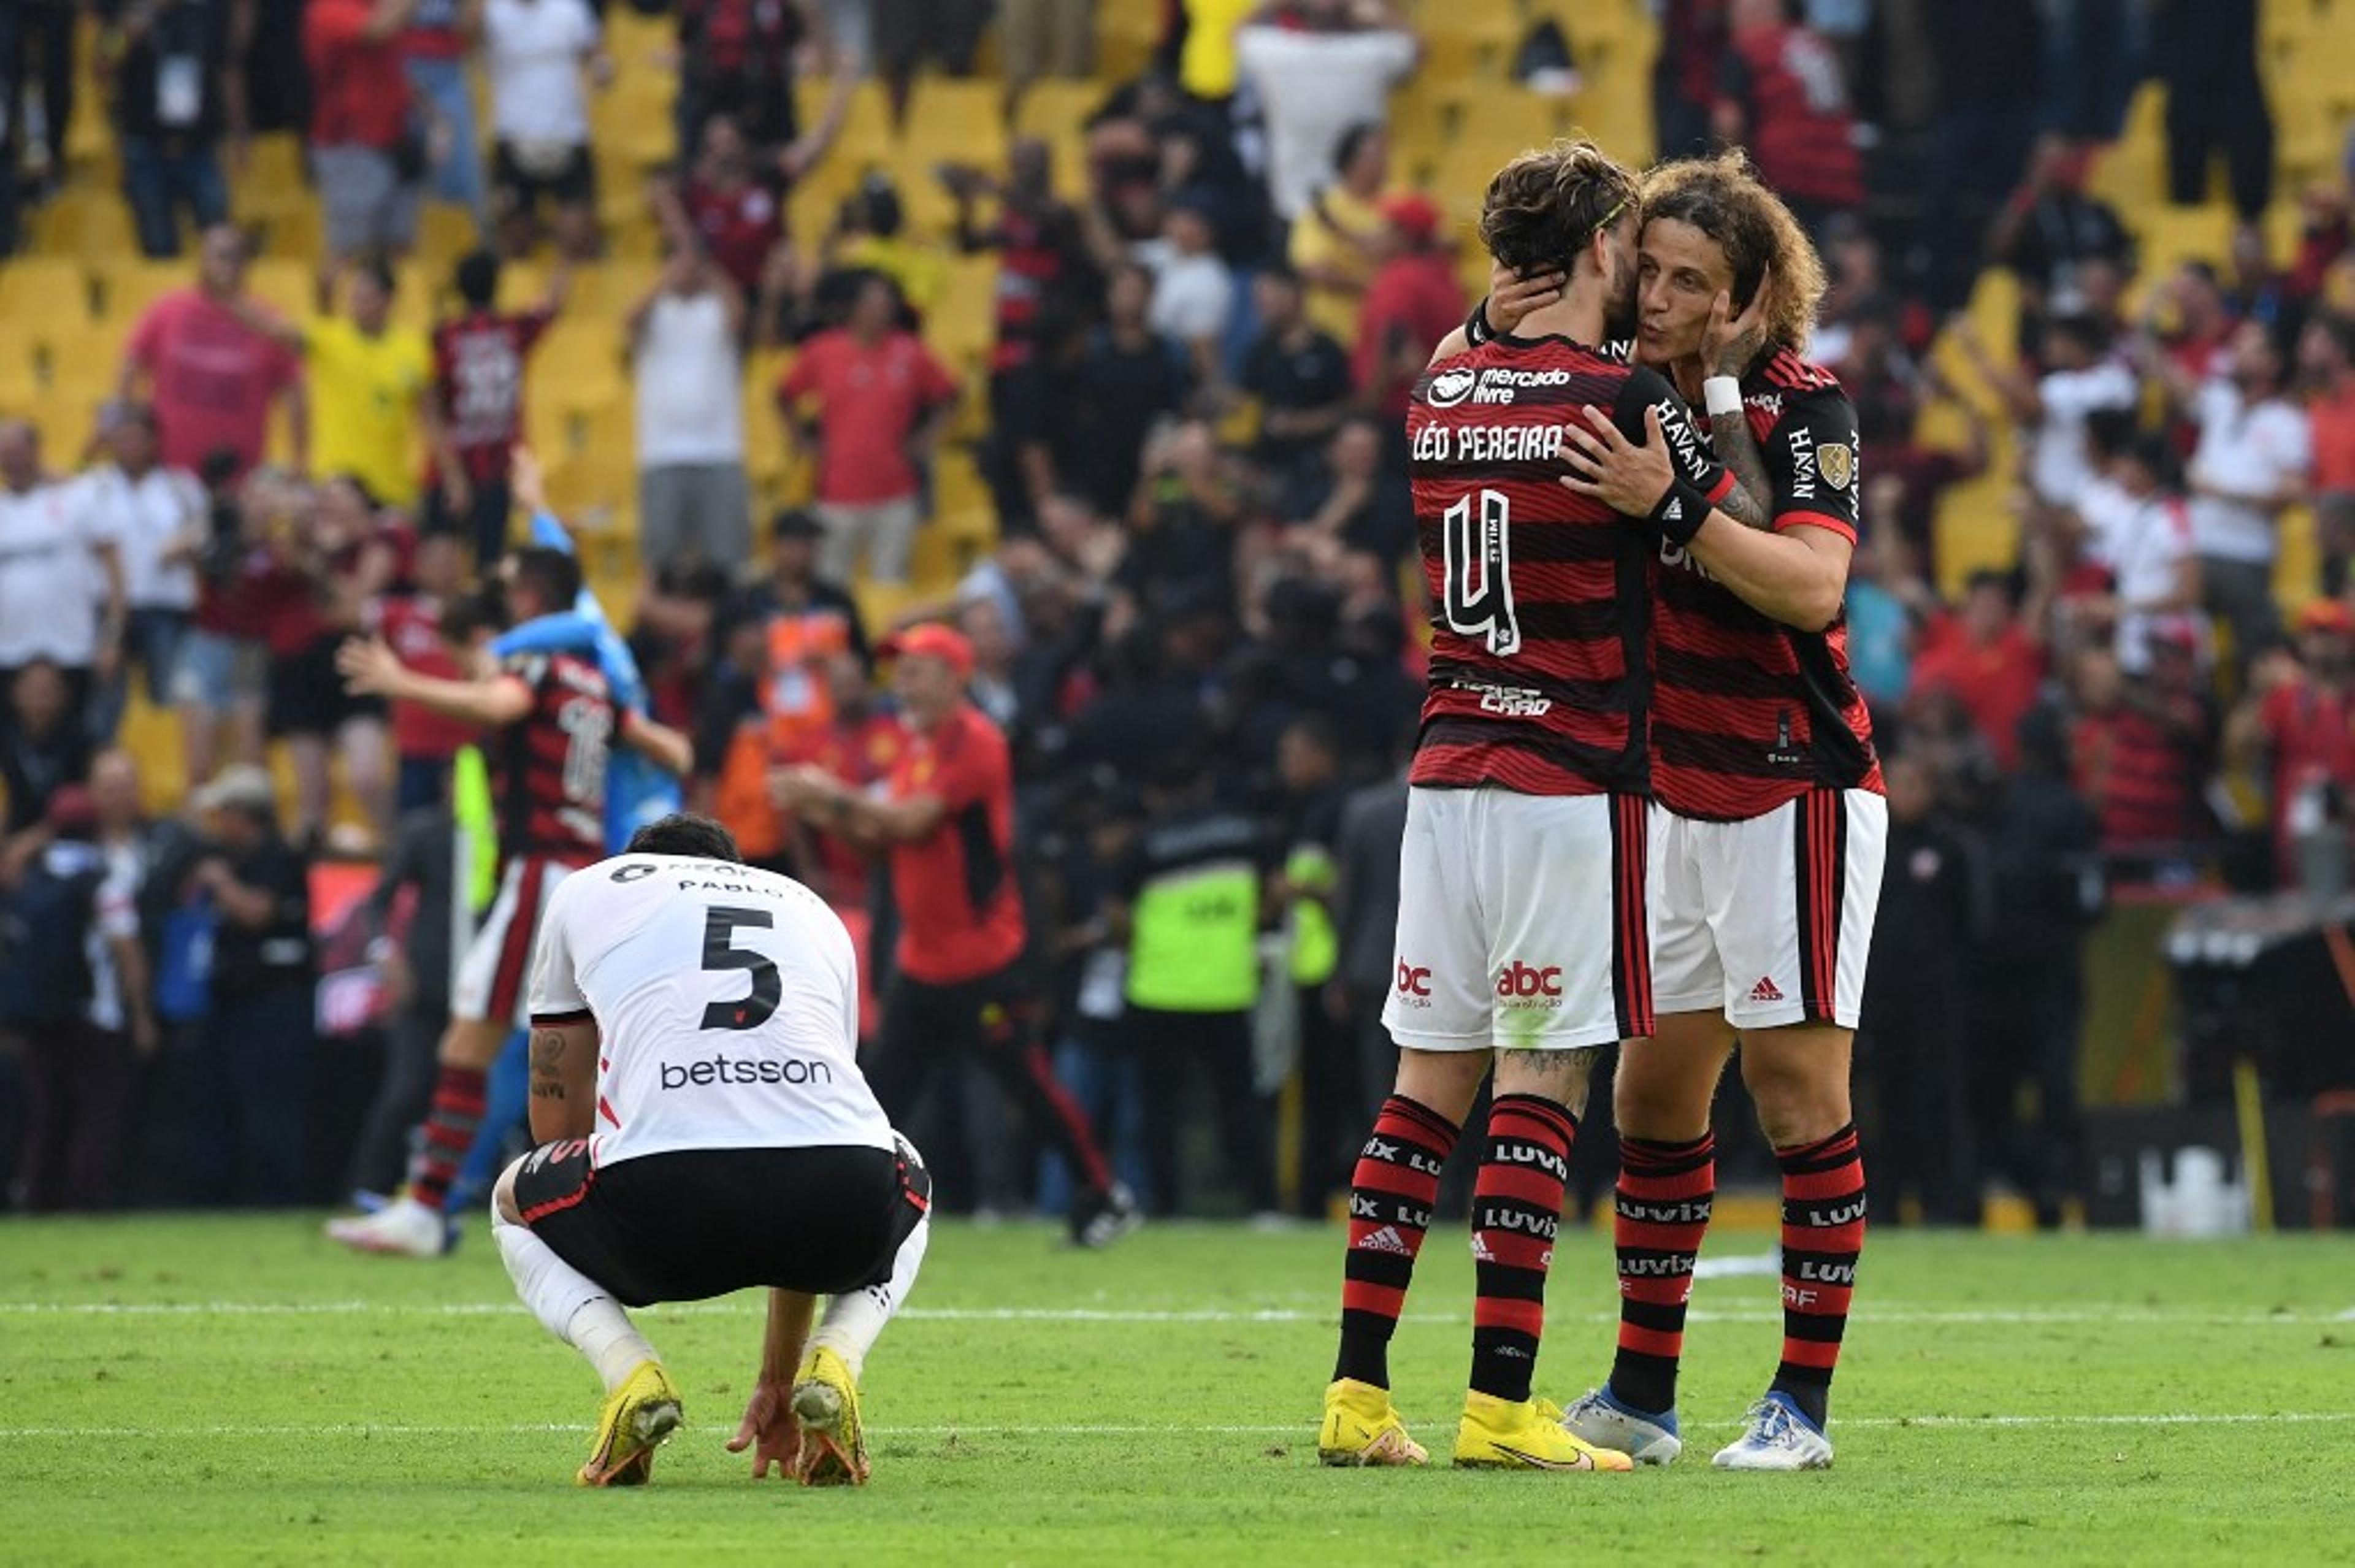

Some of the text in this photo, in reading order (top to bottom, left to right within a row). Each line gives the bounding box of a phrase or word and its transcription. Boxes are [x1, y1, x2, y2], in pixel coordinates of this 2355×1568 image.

[1473, 384, 1514, 405] livre
[1480, 369, 1570, 386] mercado
[1413, 420, 1563, 461] LÉO PEREIRA
[1656, 397, 1710, 480] HAVAN
[1788, 427, 1816, 499] HAVAN
[1444, 489, 1522, 657] 4
[1480, 693, 1552, 716] CARD
[699, 905, 782, 1030] 5
[1497, 960, 1562, 996] abc
[661, 1054, 831, 1090] betsson
